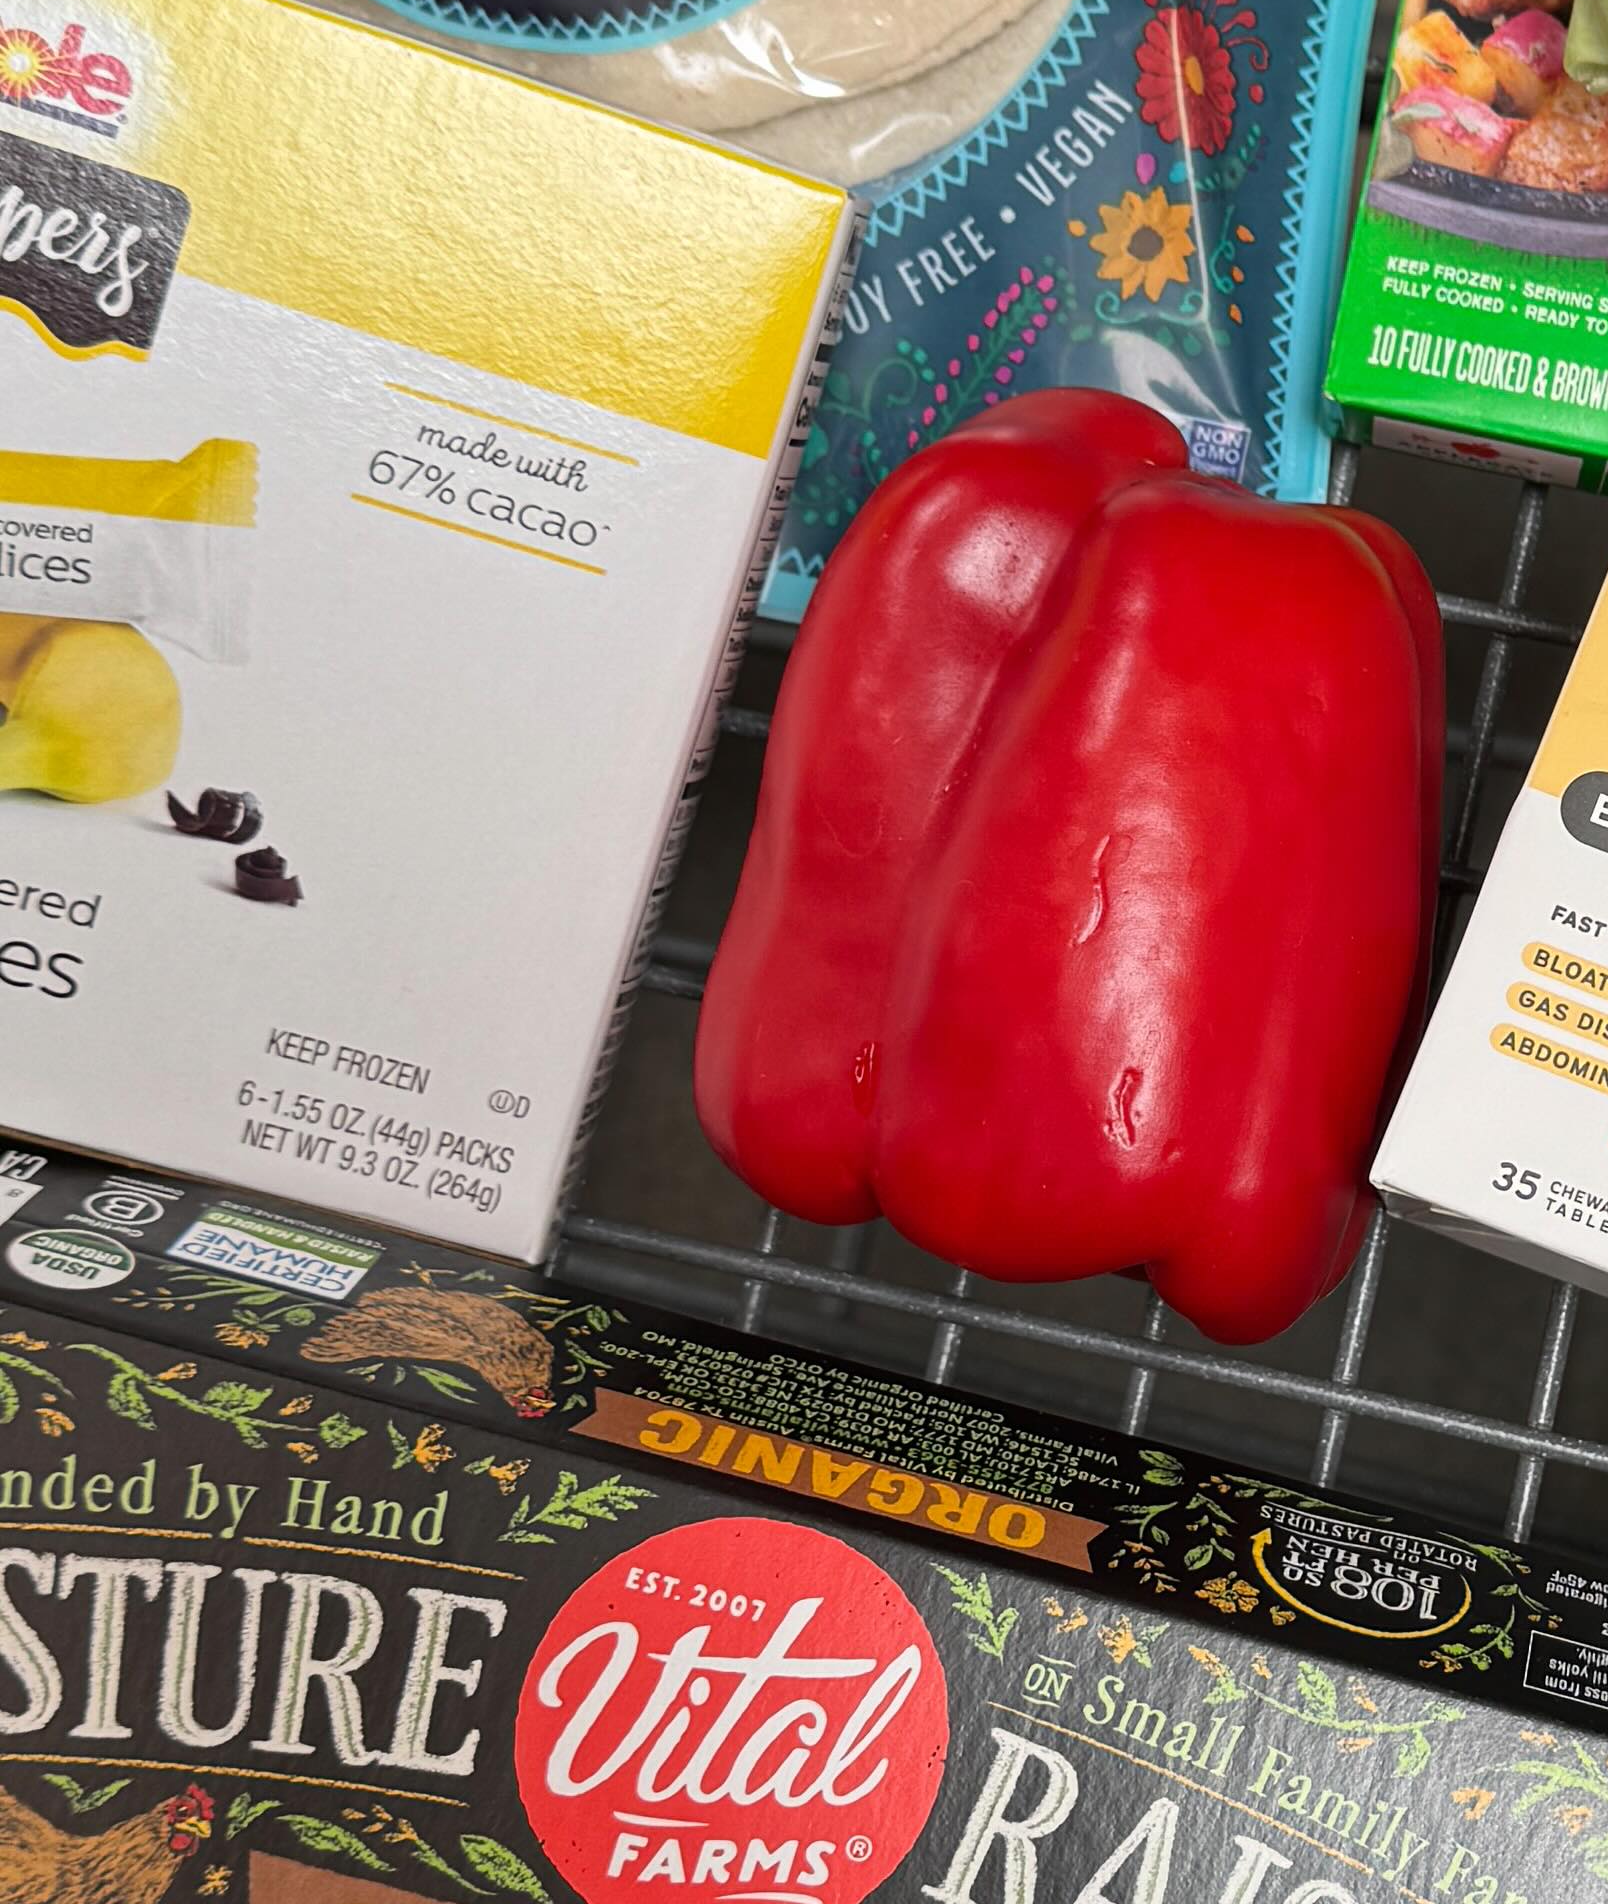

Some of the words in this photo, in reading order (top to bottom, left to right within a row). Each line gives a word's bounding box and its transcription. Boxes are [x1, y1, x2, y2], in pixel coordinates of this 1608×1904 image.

[903, 217, 995, 299] FREE
[1015, 79, 1134, 209] VEGAN
[1383, 277, 1430, 301] FULLY
[1433, 286, 1504, 313] COOKED
[1525, 304, 1581, 330] READY
[1586, 318, 1608, 334] TO
[1387, 255, 1431, 279] KEEP
[1434, 264, 1503, 290] FROZEN
[1523, 281, 1595, 311] SERVING
[1369, 325, 1396, 367] 10
[1397, 328, 1454, 377] FULLY
[1455, 341, 1530, 394] COOKED
[368, 449, 458, 504] 67%
[417, 423, 510, 471] made
[516, 451, 588, 494] with
[1551, 904, 1605, 943] FAST
[1518, 990, 1569, 1022] GAS
[267, 1027, 328, 1066] KEEP
[332, 1041, 431, 1096] FROZEN
[237, 1078, 326, 1126] 6-1.55
[329, 1102, 367, 1133] OZ.
[369, 1108, 431, 1155] (44g)
[436, 1126, 514, 1174] PACKS
[241, 1119, 292, 1160] NET
[296, 1128, 334, 1167] WT
[339, 1143, 376, 1178] 9.3
[381, 1152, 420, 1191] OZ.
[427, 1166, 502, 1215] (264g)
[1491, 1162, 1541, 1201] 35
[31, 1252, 99, 1279] USDA
[193, 1229, 354, 1279] HUMANE
[186, 1463, 258, 1538] by
[281, 1476, 447, 1546] Hand
[639, 1410, 1046, 1548] ORGANIC
[1260, 1505, 1370, 1543] PASTURES
[1286, 1535, 1361, 1567] HEN
[1371, 1559, 1441, 1589] PER
[1380, 1534, 1478, 1572] ROTATED
[625, 1566, 681, 1602] EST.
[689, 1583, 767, 1622] 2007
[1330, 1565, 1440, 1620] 108
[537, 1597, 922, 1807] Vital
[1024, 1662, 1072, 1699] ON
[1083, 1674, 1245, 1778] Small
[1244, 1737, 1434, 1883] Family
